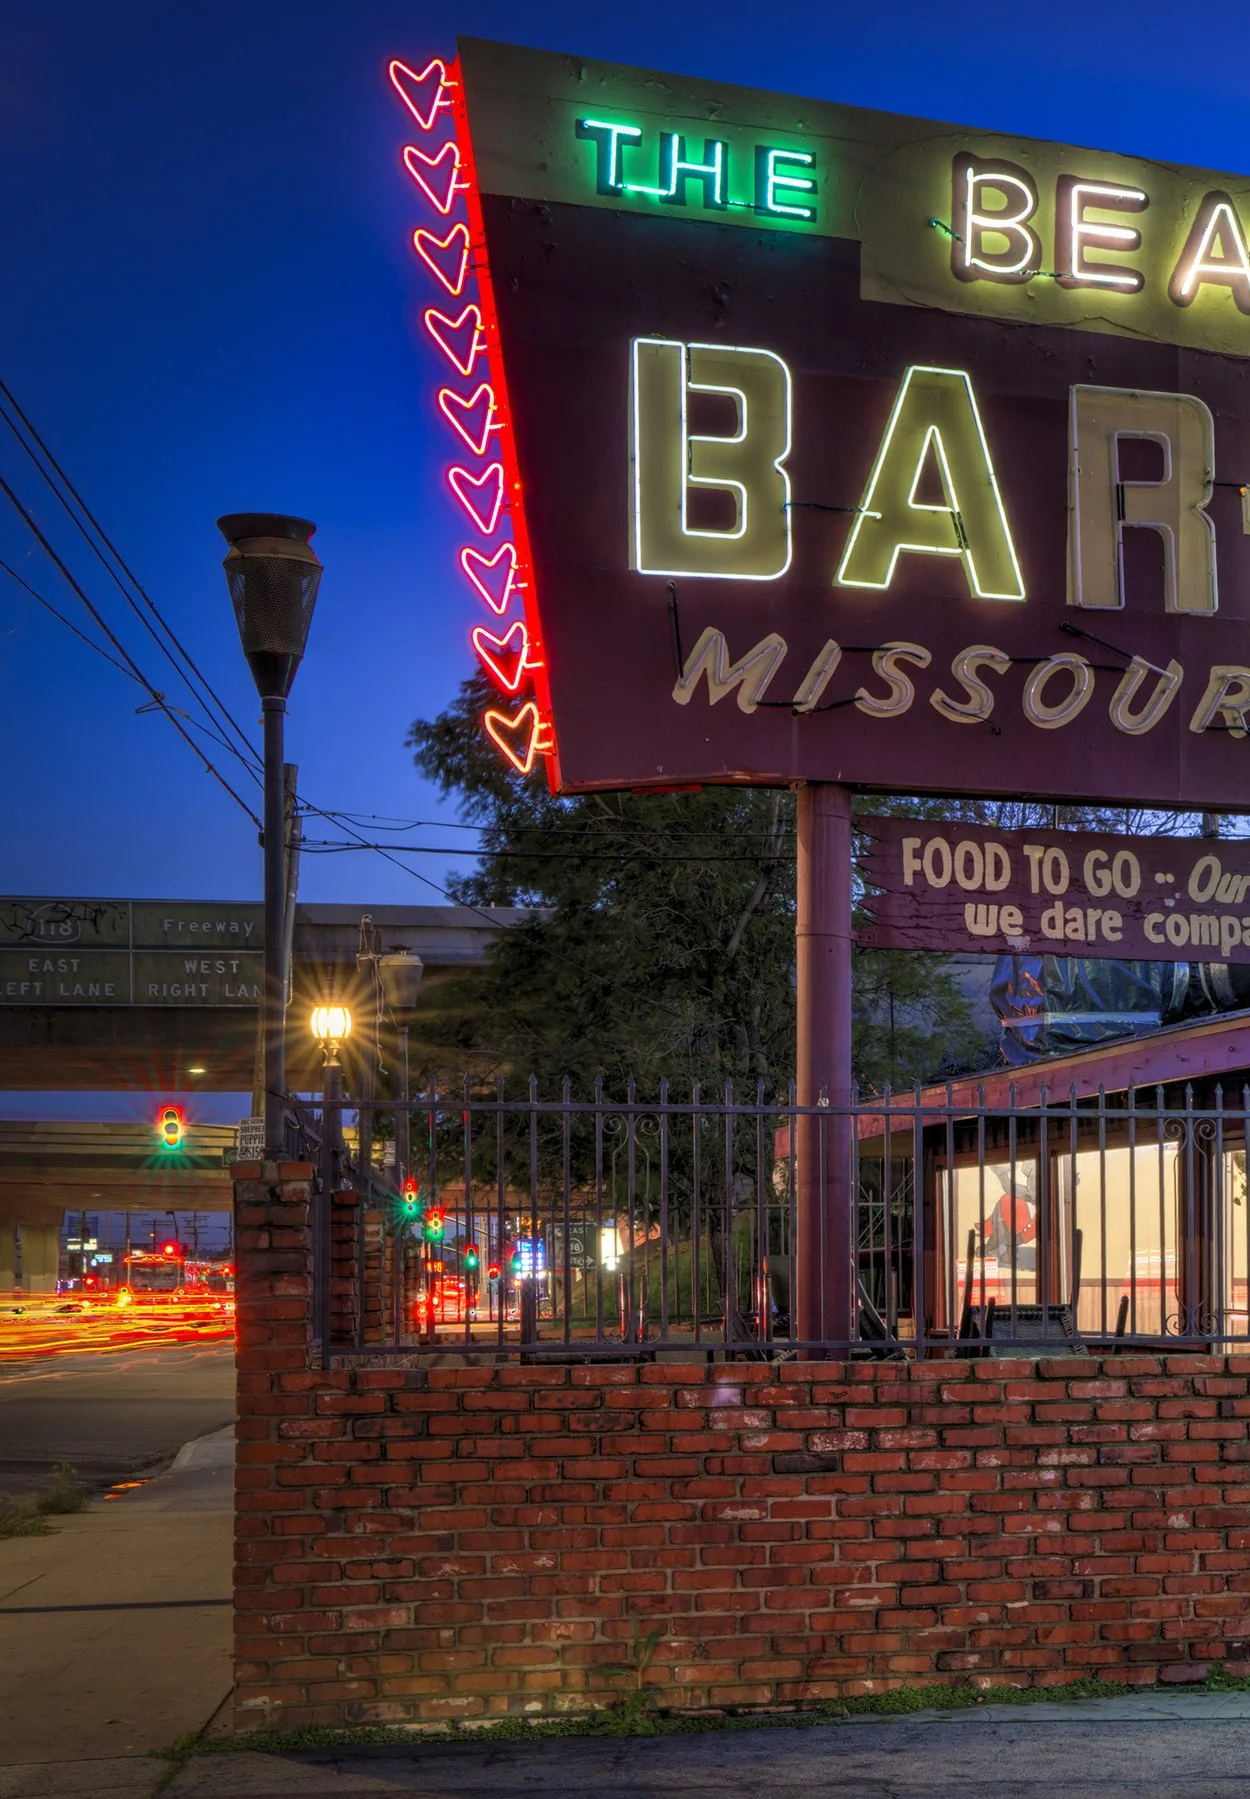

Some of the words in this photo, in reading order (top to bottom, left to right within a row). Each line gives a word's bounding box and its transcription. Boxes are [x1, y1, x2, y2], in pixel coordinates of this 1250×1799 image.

[575, 117, 818, 222] THE
[902, 836, 1011, 892] FOOD
[1023, 845, 1069, 895] TO
[1083, 849, 1141, 898] GO
[163, 919, 254, 937] Freeway
[964, 902, 1023, 936] we
[1041, 901, 1123, 942] dare
[28, 958, 80, 972] EAST
[184, 960, 240, 974] WEST
[0, 982, 42, 996] EFT
[60, 982, 115, 997] LANE
[148, 983, 208, 998] RIGHT
[225, 984, 262, 998] LAN
[240, 1134, 265, 1145] PUPPIE
